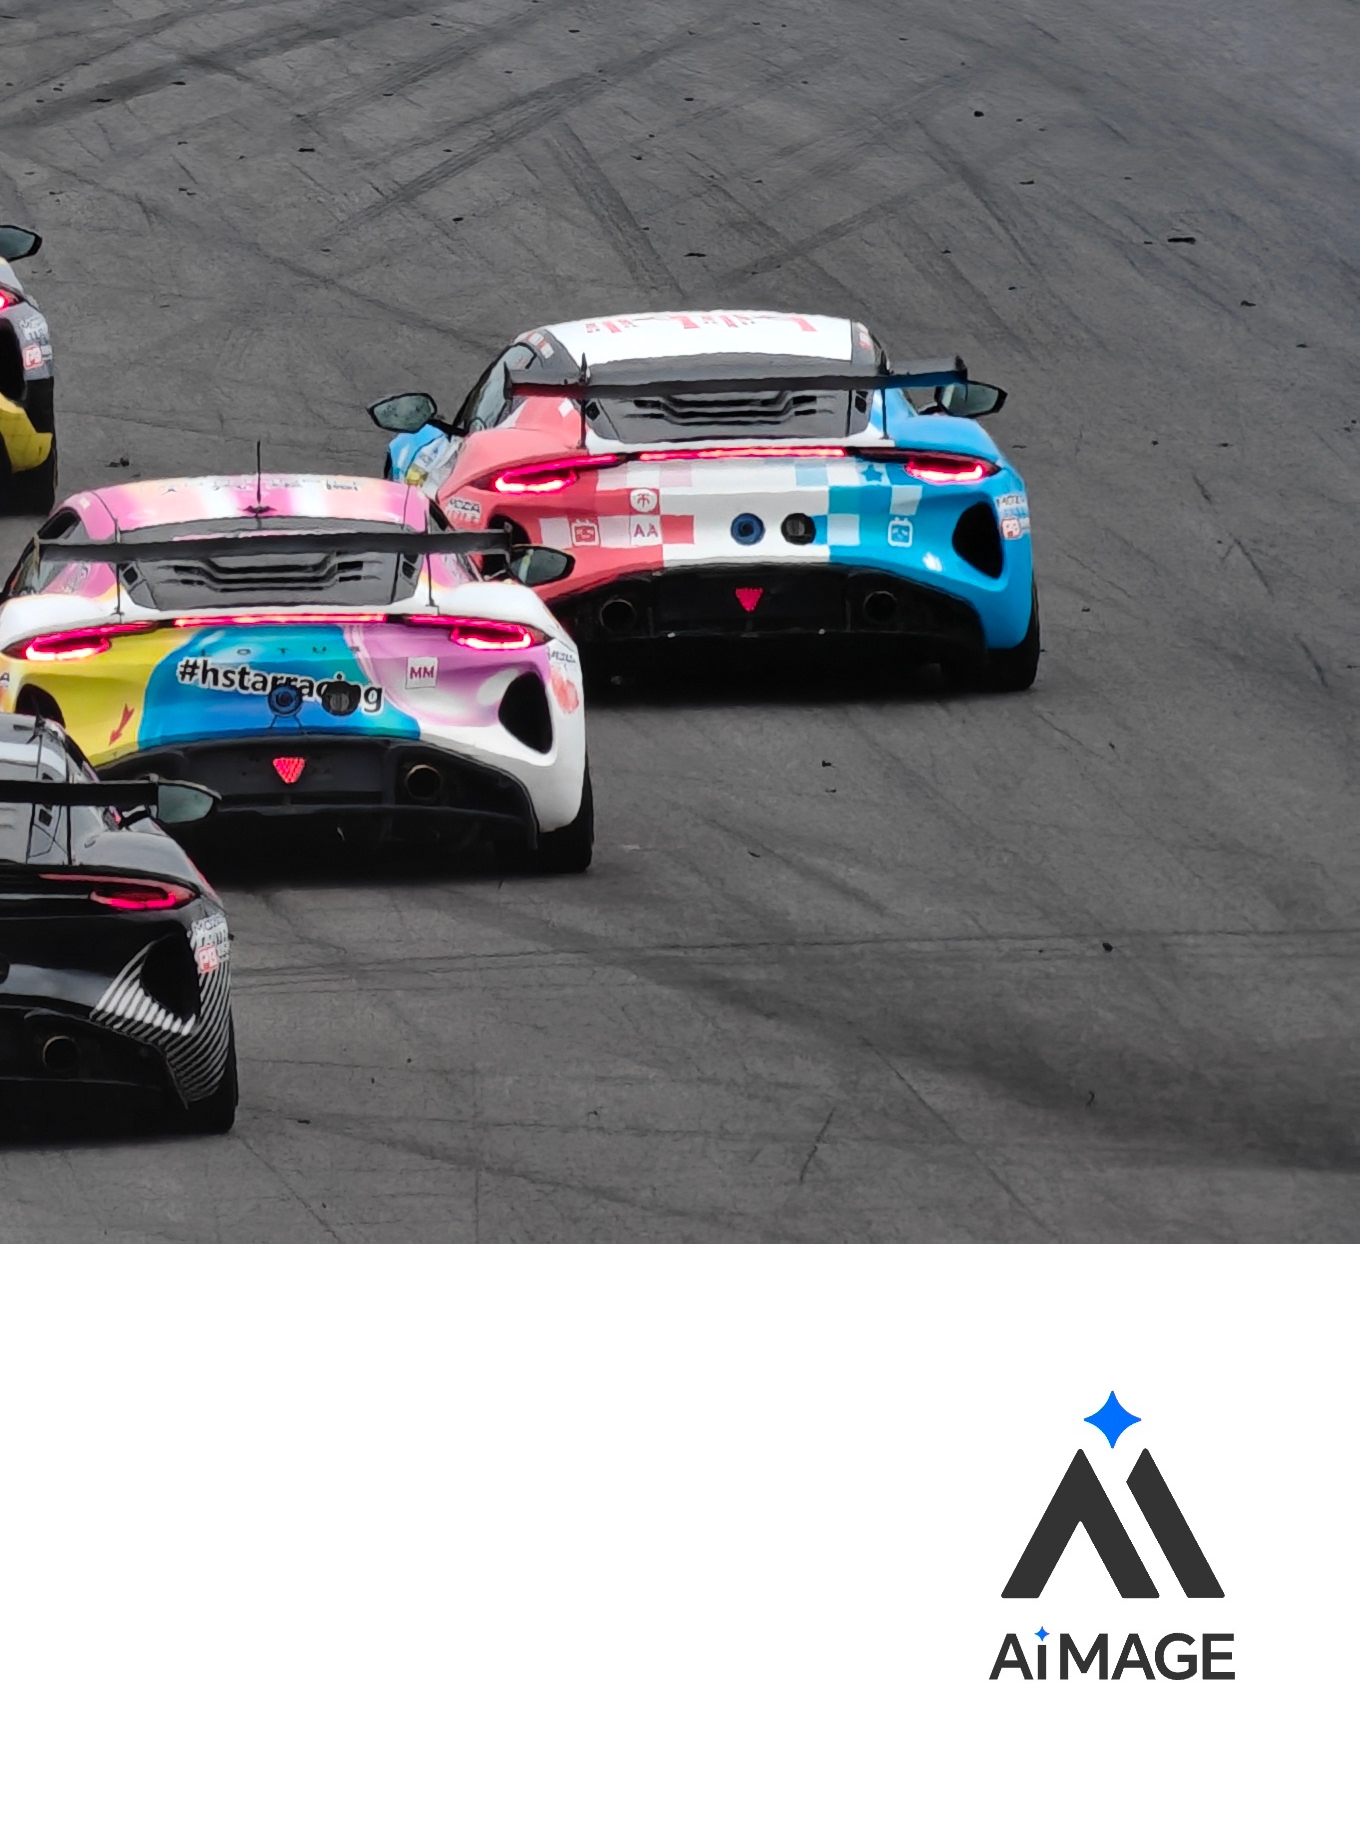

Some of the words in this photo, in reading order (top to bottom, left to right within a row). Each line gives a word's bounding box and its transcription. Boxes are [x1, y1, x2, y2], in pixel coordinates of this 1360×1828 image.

[633, 523, 659, 538] AA
[409, 666, 435, 680] MM
[178, 658, 384, 713] #hstarracg
